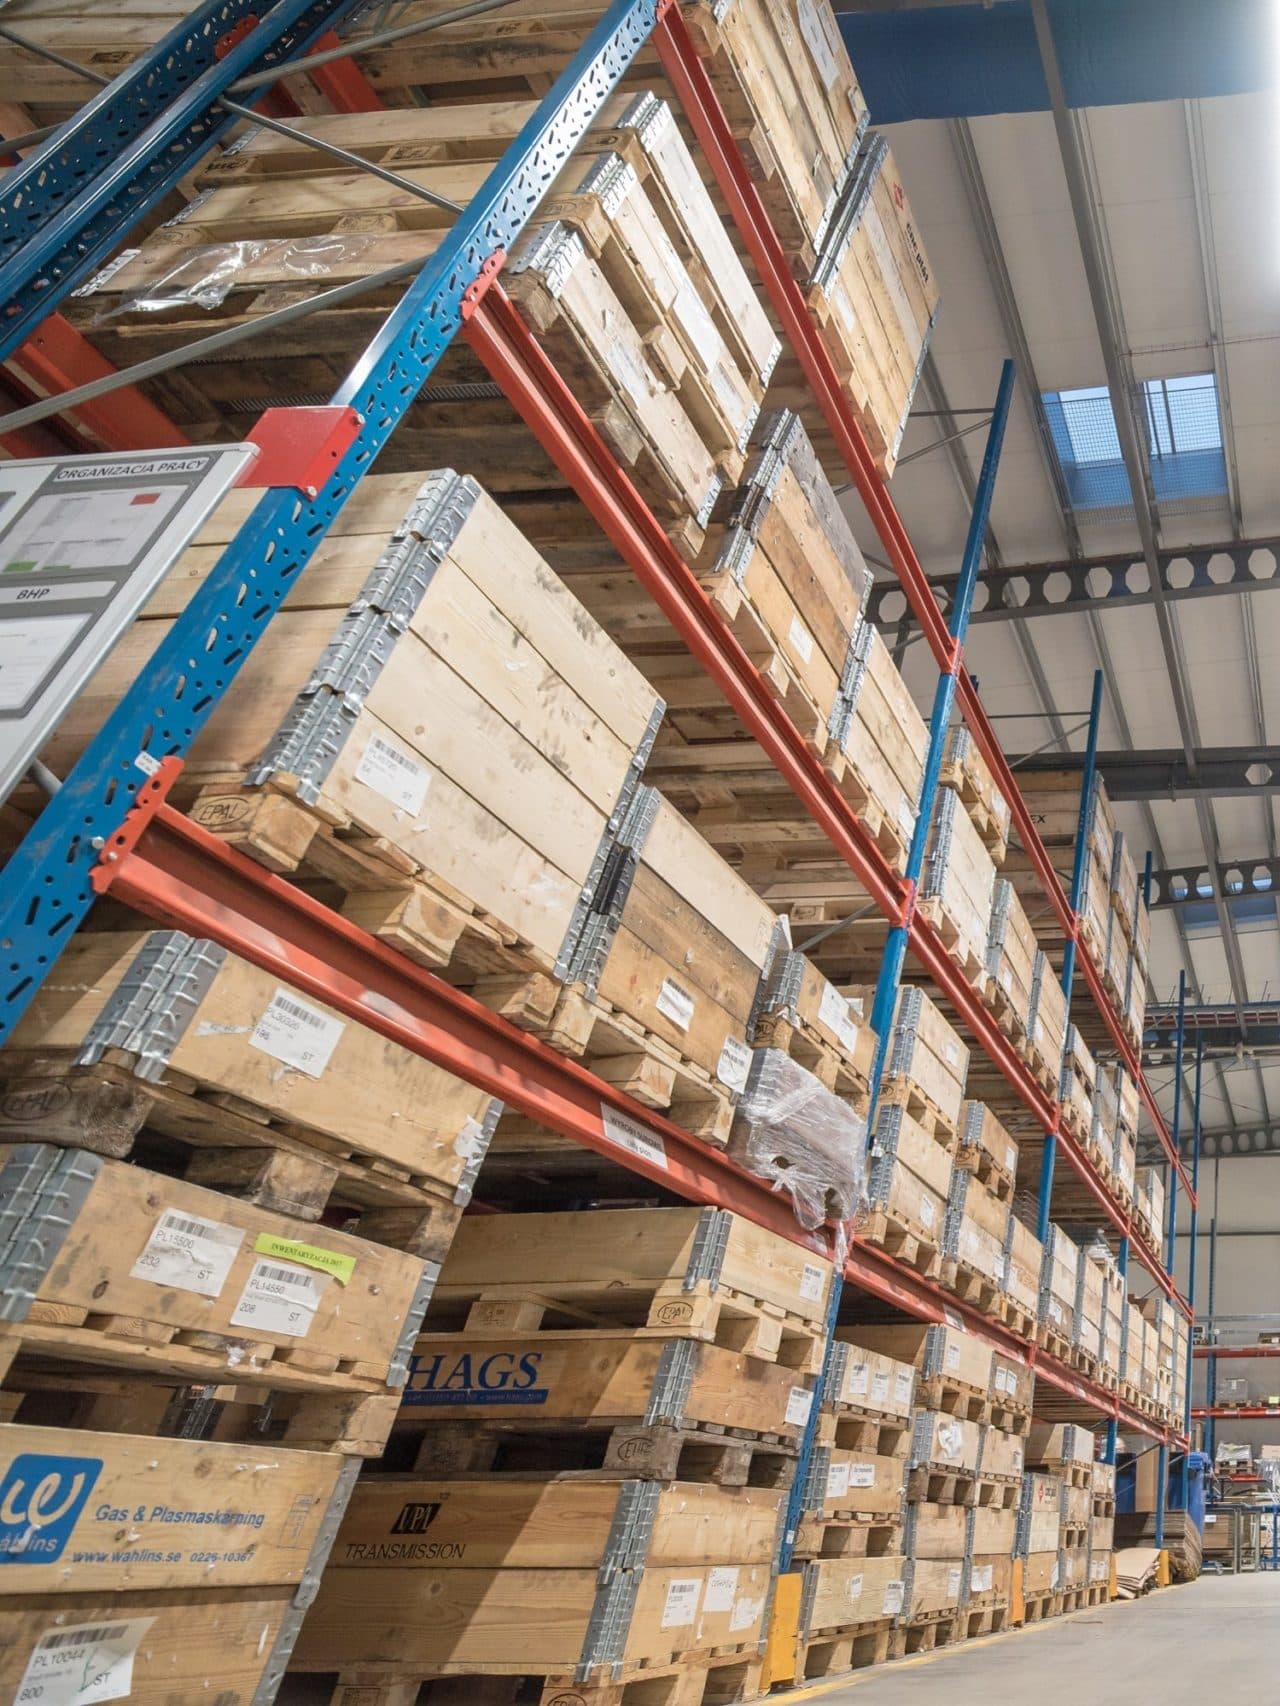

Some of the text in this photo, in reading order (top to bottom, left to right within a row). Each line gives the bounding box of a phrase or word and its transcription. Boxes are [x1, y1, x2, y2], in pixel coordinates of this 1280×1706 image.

[57, 459, 205, 480] ORGANIZACJA PRACY
[16, 588, 51, 600] BHP
[139, 1254, 160, 1268] 232
[197, 1269, 213, 1280] ST
[288, 1312, 301, 1322] ST
[405, 1352, 543, 1390] HAGS
[96, 1504, 265, 1529] Gas & Plasmaskärning
[73, 1550, 182, 1563] www.wahlins.se
[345, 1543, 466, 1560] TRANSMISSION
[94, 1672, 111, 1686] ST
[20, 1686, 43, 1701] 800
